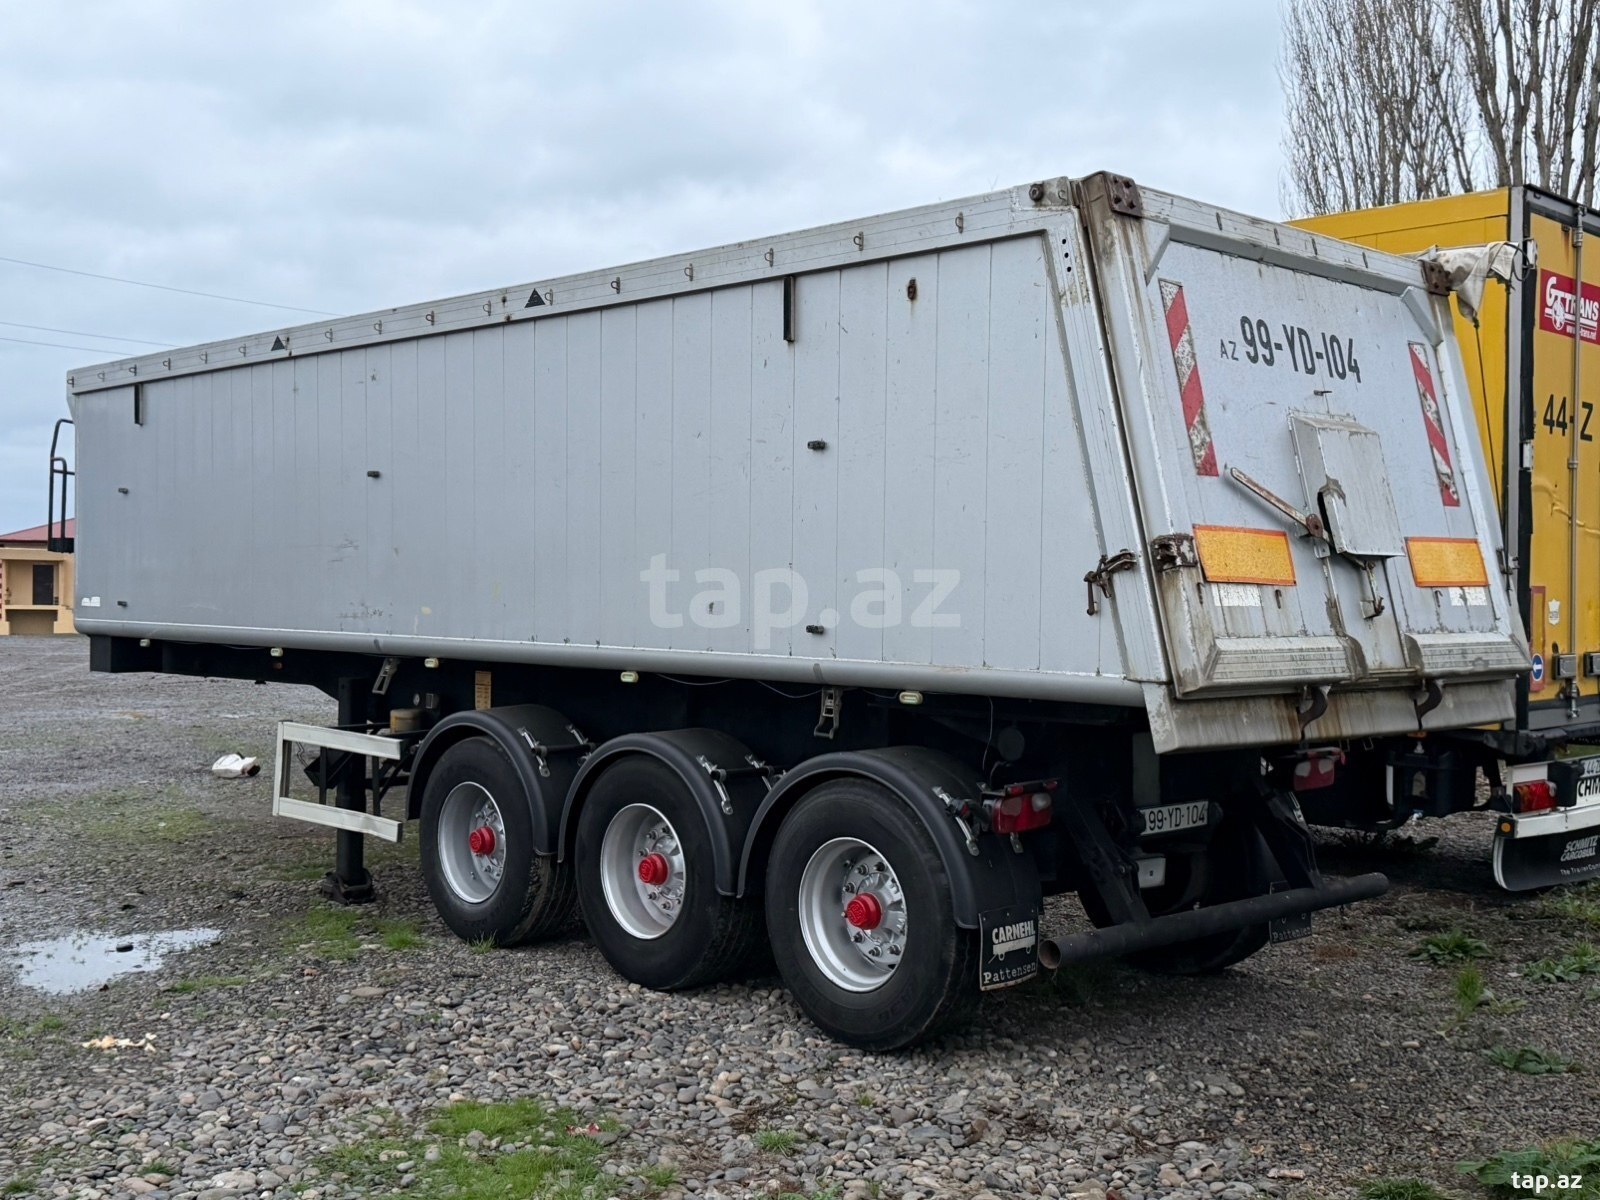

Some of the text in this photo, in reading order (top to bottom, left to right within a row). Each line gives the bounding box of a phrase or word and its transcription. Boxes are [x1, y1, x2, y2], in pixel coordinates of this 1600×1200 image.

[1220, 315, 1361, 383] AZ 99-YD-104
[1560, 846, 1596, 862] CARCOBULL
[1564, 835, 1599, 853] SCHMITZ
[992, 920, 1036, 944] CARNEHL
[983, 962, 1036, 984] Pattensen
